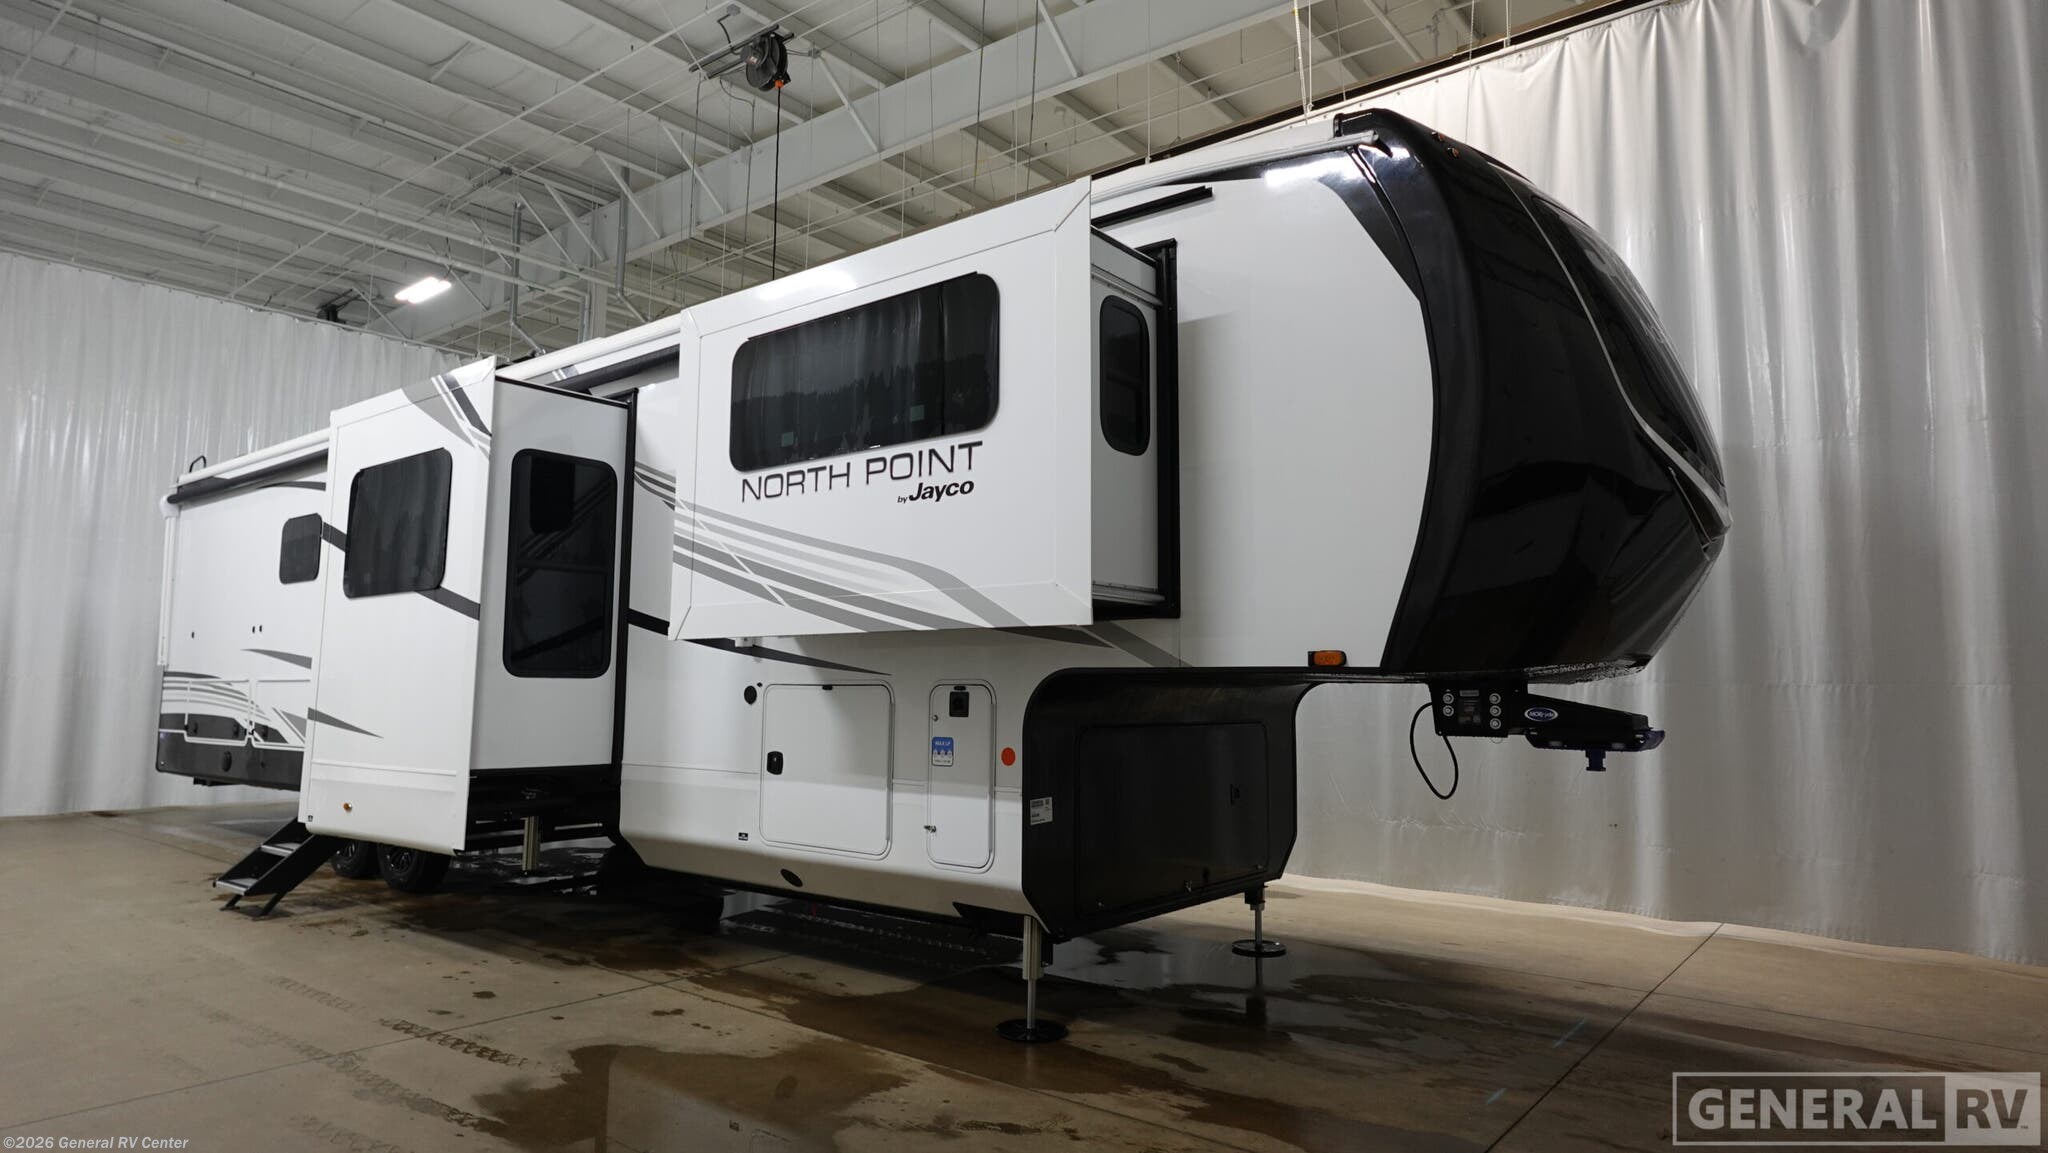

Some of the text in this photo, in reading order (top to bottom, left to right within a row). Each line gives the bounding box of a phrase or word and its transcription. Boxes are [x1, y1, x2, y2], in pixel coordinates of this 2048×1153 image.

[742, 440, 984, 503] NORTH POINT
[897, 480, 975, 504] by Jayco
